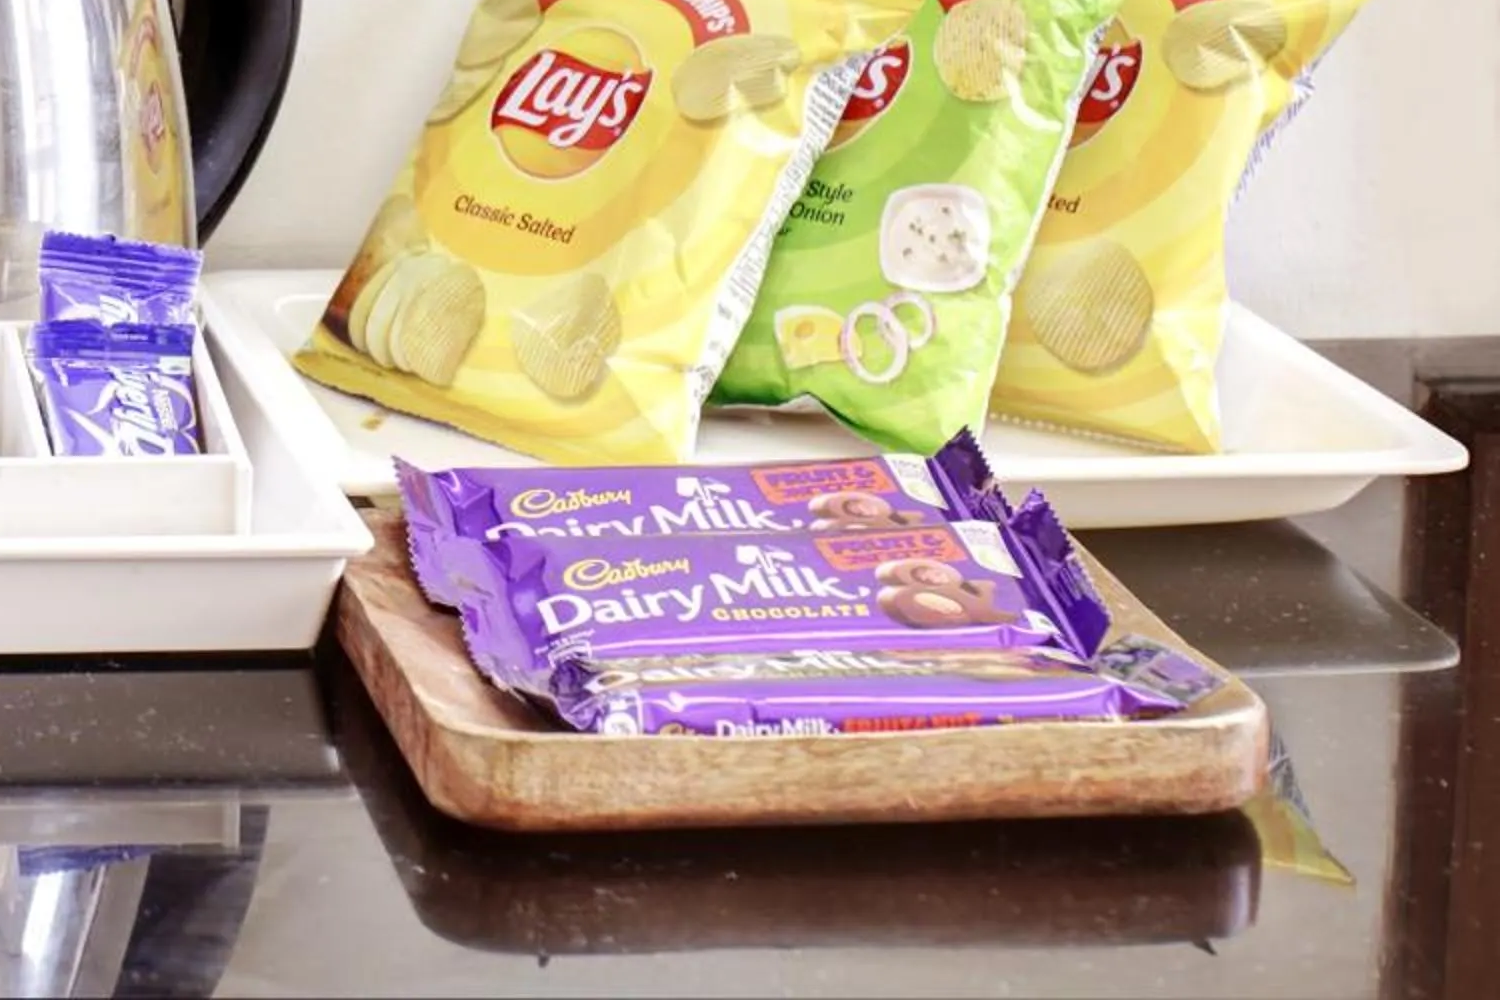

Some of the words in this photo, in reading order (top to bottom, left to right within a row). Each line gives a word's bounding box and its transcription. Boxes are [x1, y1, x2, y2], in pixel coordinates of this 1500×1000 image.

[498, 51, 644, 148] Lay's
[806, 179, 853, 206] Style
[1047, 192, 1081, 214] ted
[454, 194, 515, 226] Classic
[516, 212, 576, 244] Salted
[789, 202, 845, 226] Onion
[510, 487, 632, 518] Cadbury
[649, 497, 800, 534] Milk
[563, 557, 690, 590] Cadbury
[537, 584, 704, 635] Dairy
[709, 566, 866, 605] Milk
[710, 603, 870, 621] CHOCOLATE
